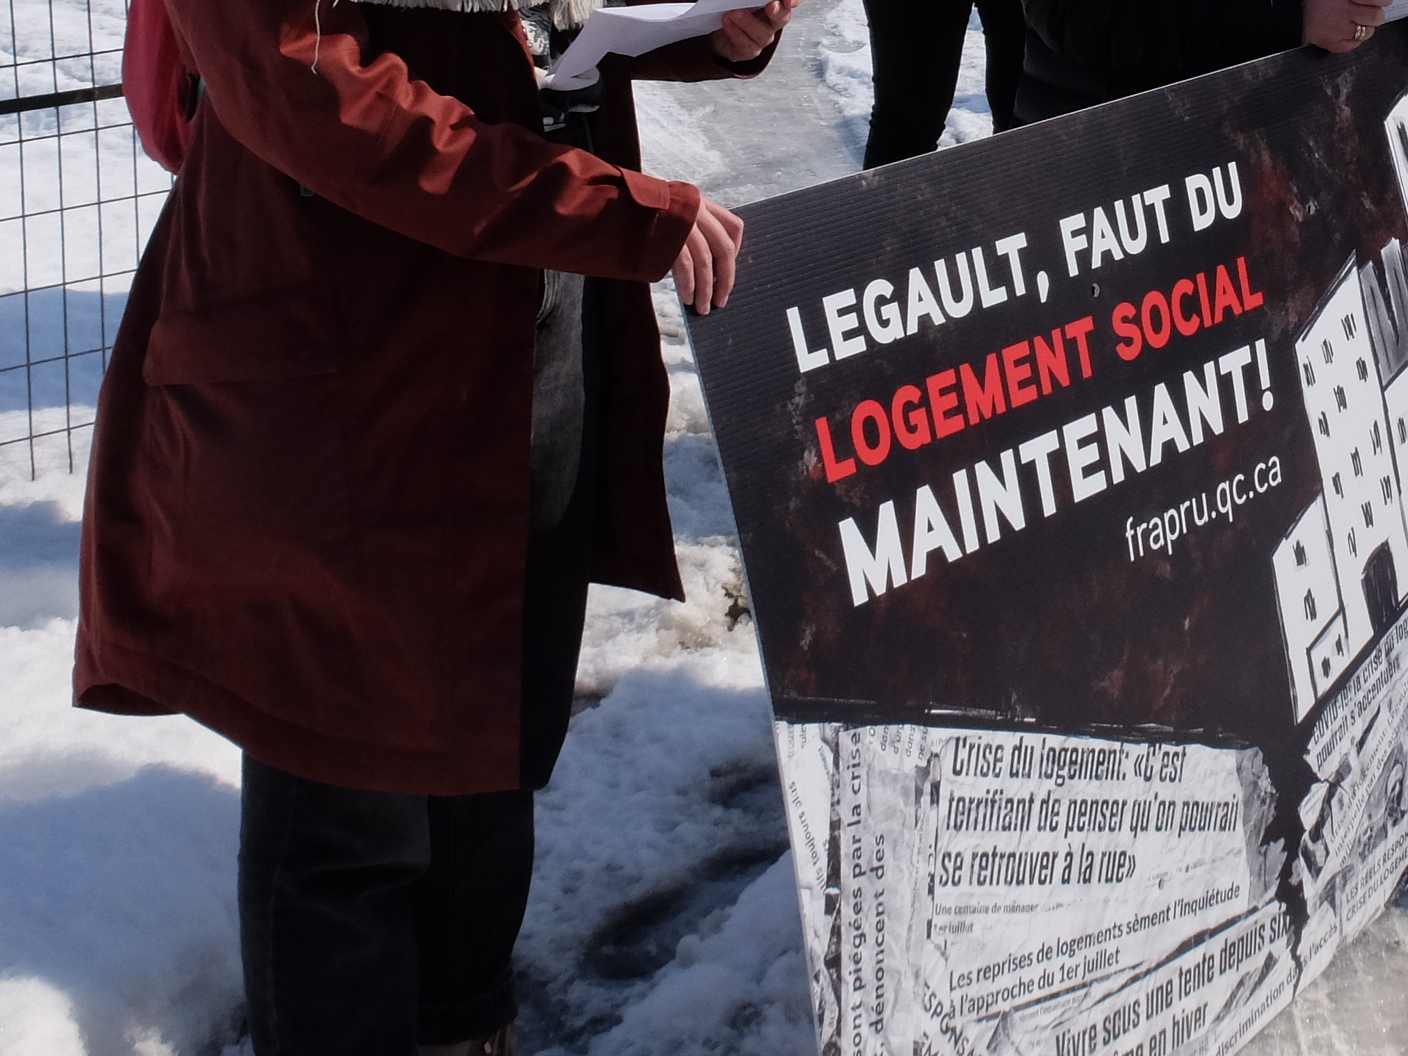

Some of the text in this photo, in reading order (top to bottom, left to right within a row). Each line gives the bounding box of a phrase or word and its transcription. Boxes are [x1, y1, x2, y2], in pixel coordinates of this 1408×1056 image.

[786, 161, 1243, 372] LEGAULT, FAUT DU
[814, 256, 1265, 483] LOGEMENT SOCIAL
[838, 338, 1274, 606] MAINTENANT!
[1125, 455, 1283, 561] frapru.qc.ca
[1362, 644, 1385, 684] crise
[951, 736, 1004, 778] Crise
[1009, 736, 1035, 779] du
[1038, 740, 1127, 787] logement:
[1133, 745, 1187, 784] «C'est
[946, 789, 1239, 842] terrifiant de penser qu'on pourrait
[847, 732, 867, 992] piégées par la crise
[939, 842, 1136, 887] se retrouver à la rue»
[1345, 883, 1360, 904] LES
[1360, 853, 1382, 890] RÉELS
[869, 832, 885, 1035] dénoncent des
[949, 881, 1241, 992] Les reprises de logements sèment l'inquiétude
[1346, 896, 1367, 923] CRISE
[1367, 882, 1379, 904] DU
[961, 977, 1035, 1017] l'approche
[1037, 974, 1056, 999] du
[1058, 963, 1081, 987] 1er
[1081, 947, 1121, 985] juillet
[1055, 1014, 1097, 1056] Vivre
[1102, 1004, 1141, 1046] sous
[1145, 985, 1174, 1021] une
[1178, 957, 1216, 1004] tente
[1218, 924, 1267, 980] depuis
[1215, 980, 1286, 1056] discrimination
[1171, 1000, 1209, 1051] hiver
